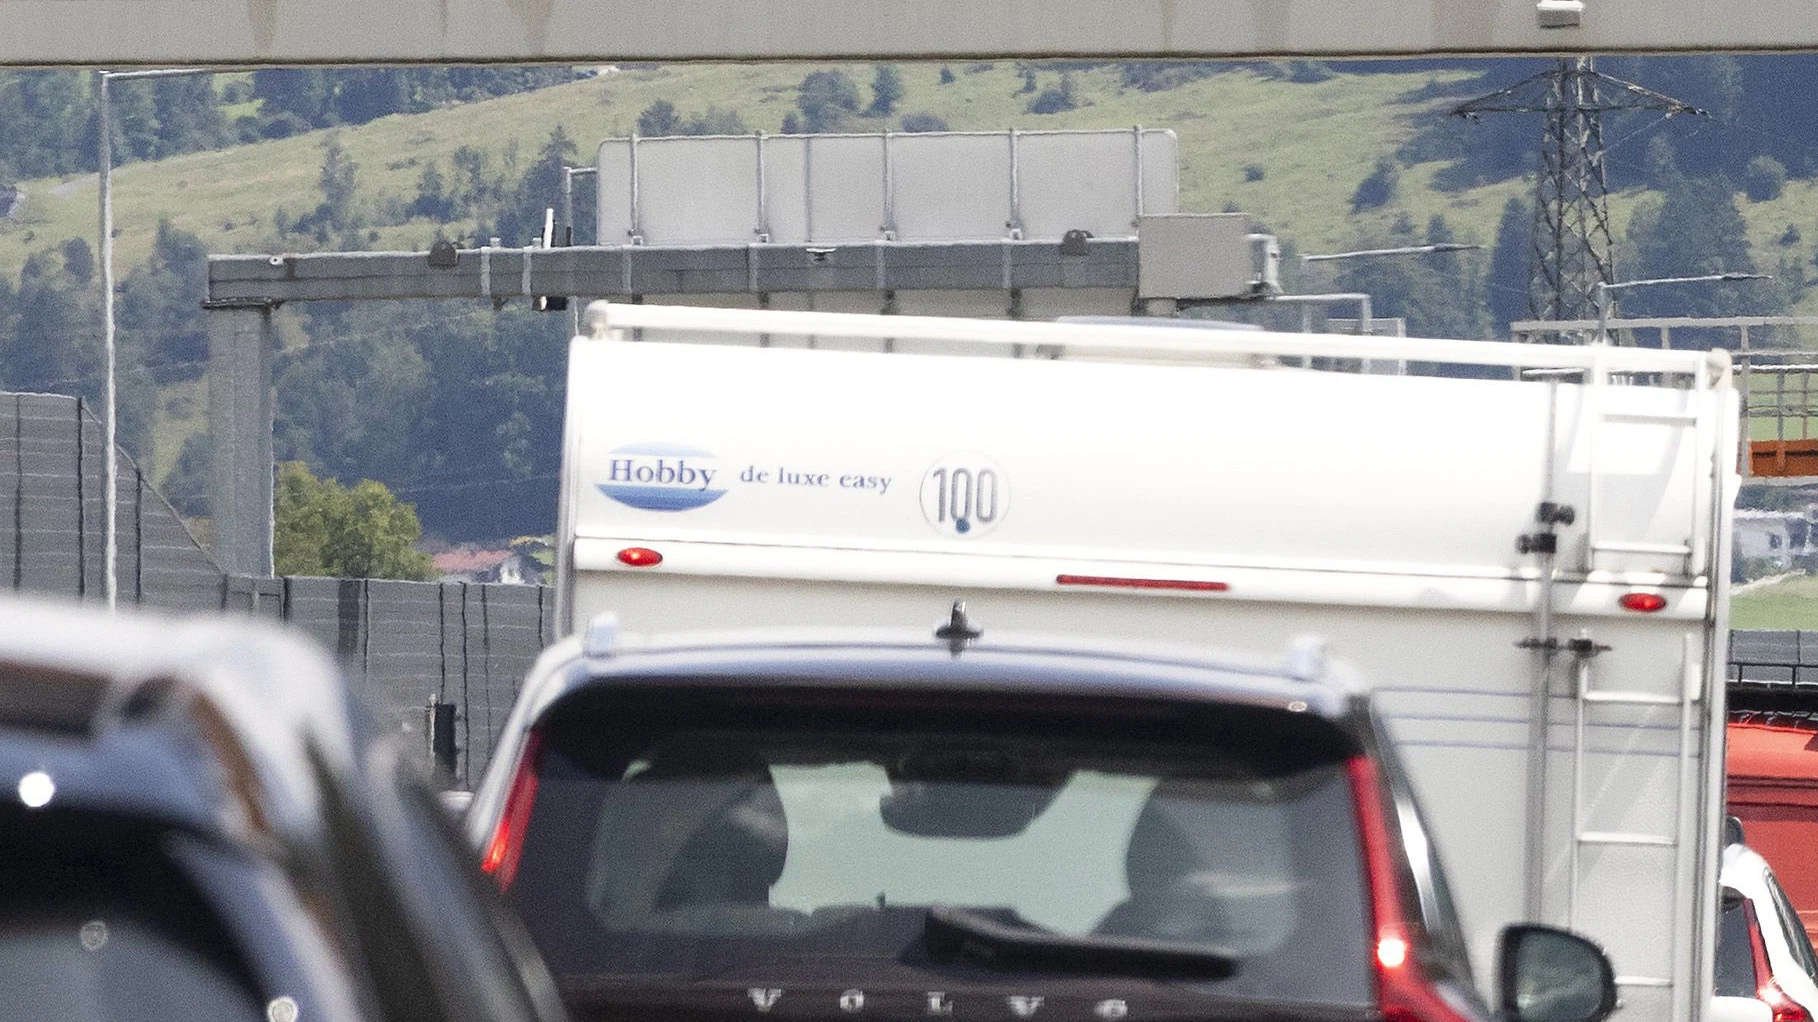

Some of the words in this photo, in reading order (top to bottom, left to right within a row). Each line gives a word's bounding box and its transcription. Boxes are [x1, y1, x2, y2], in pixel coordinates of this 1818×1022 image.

[609, 459, 717, 491] Hobby
[740, 466, 769, 483] de
[778, 468, 830, 487] luxe
[839, 473, 892, 494] easy
[933, 467, 998, 523] 100
[747, 987, 1129, 1020] VOLVO
